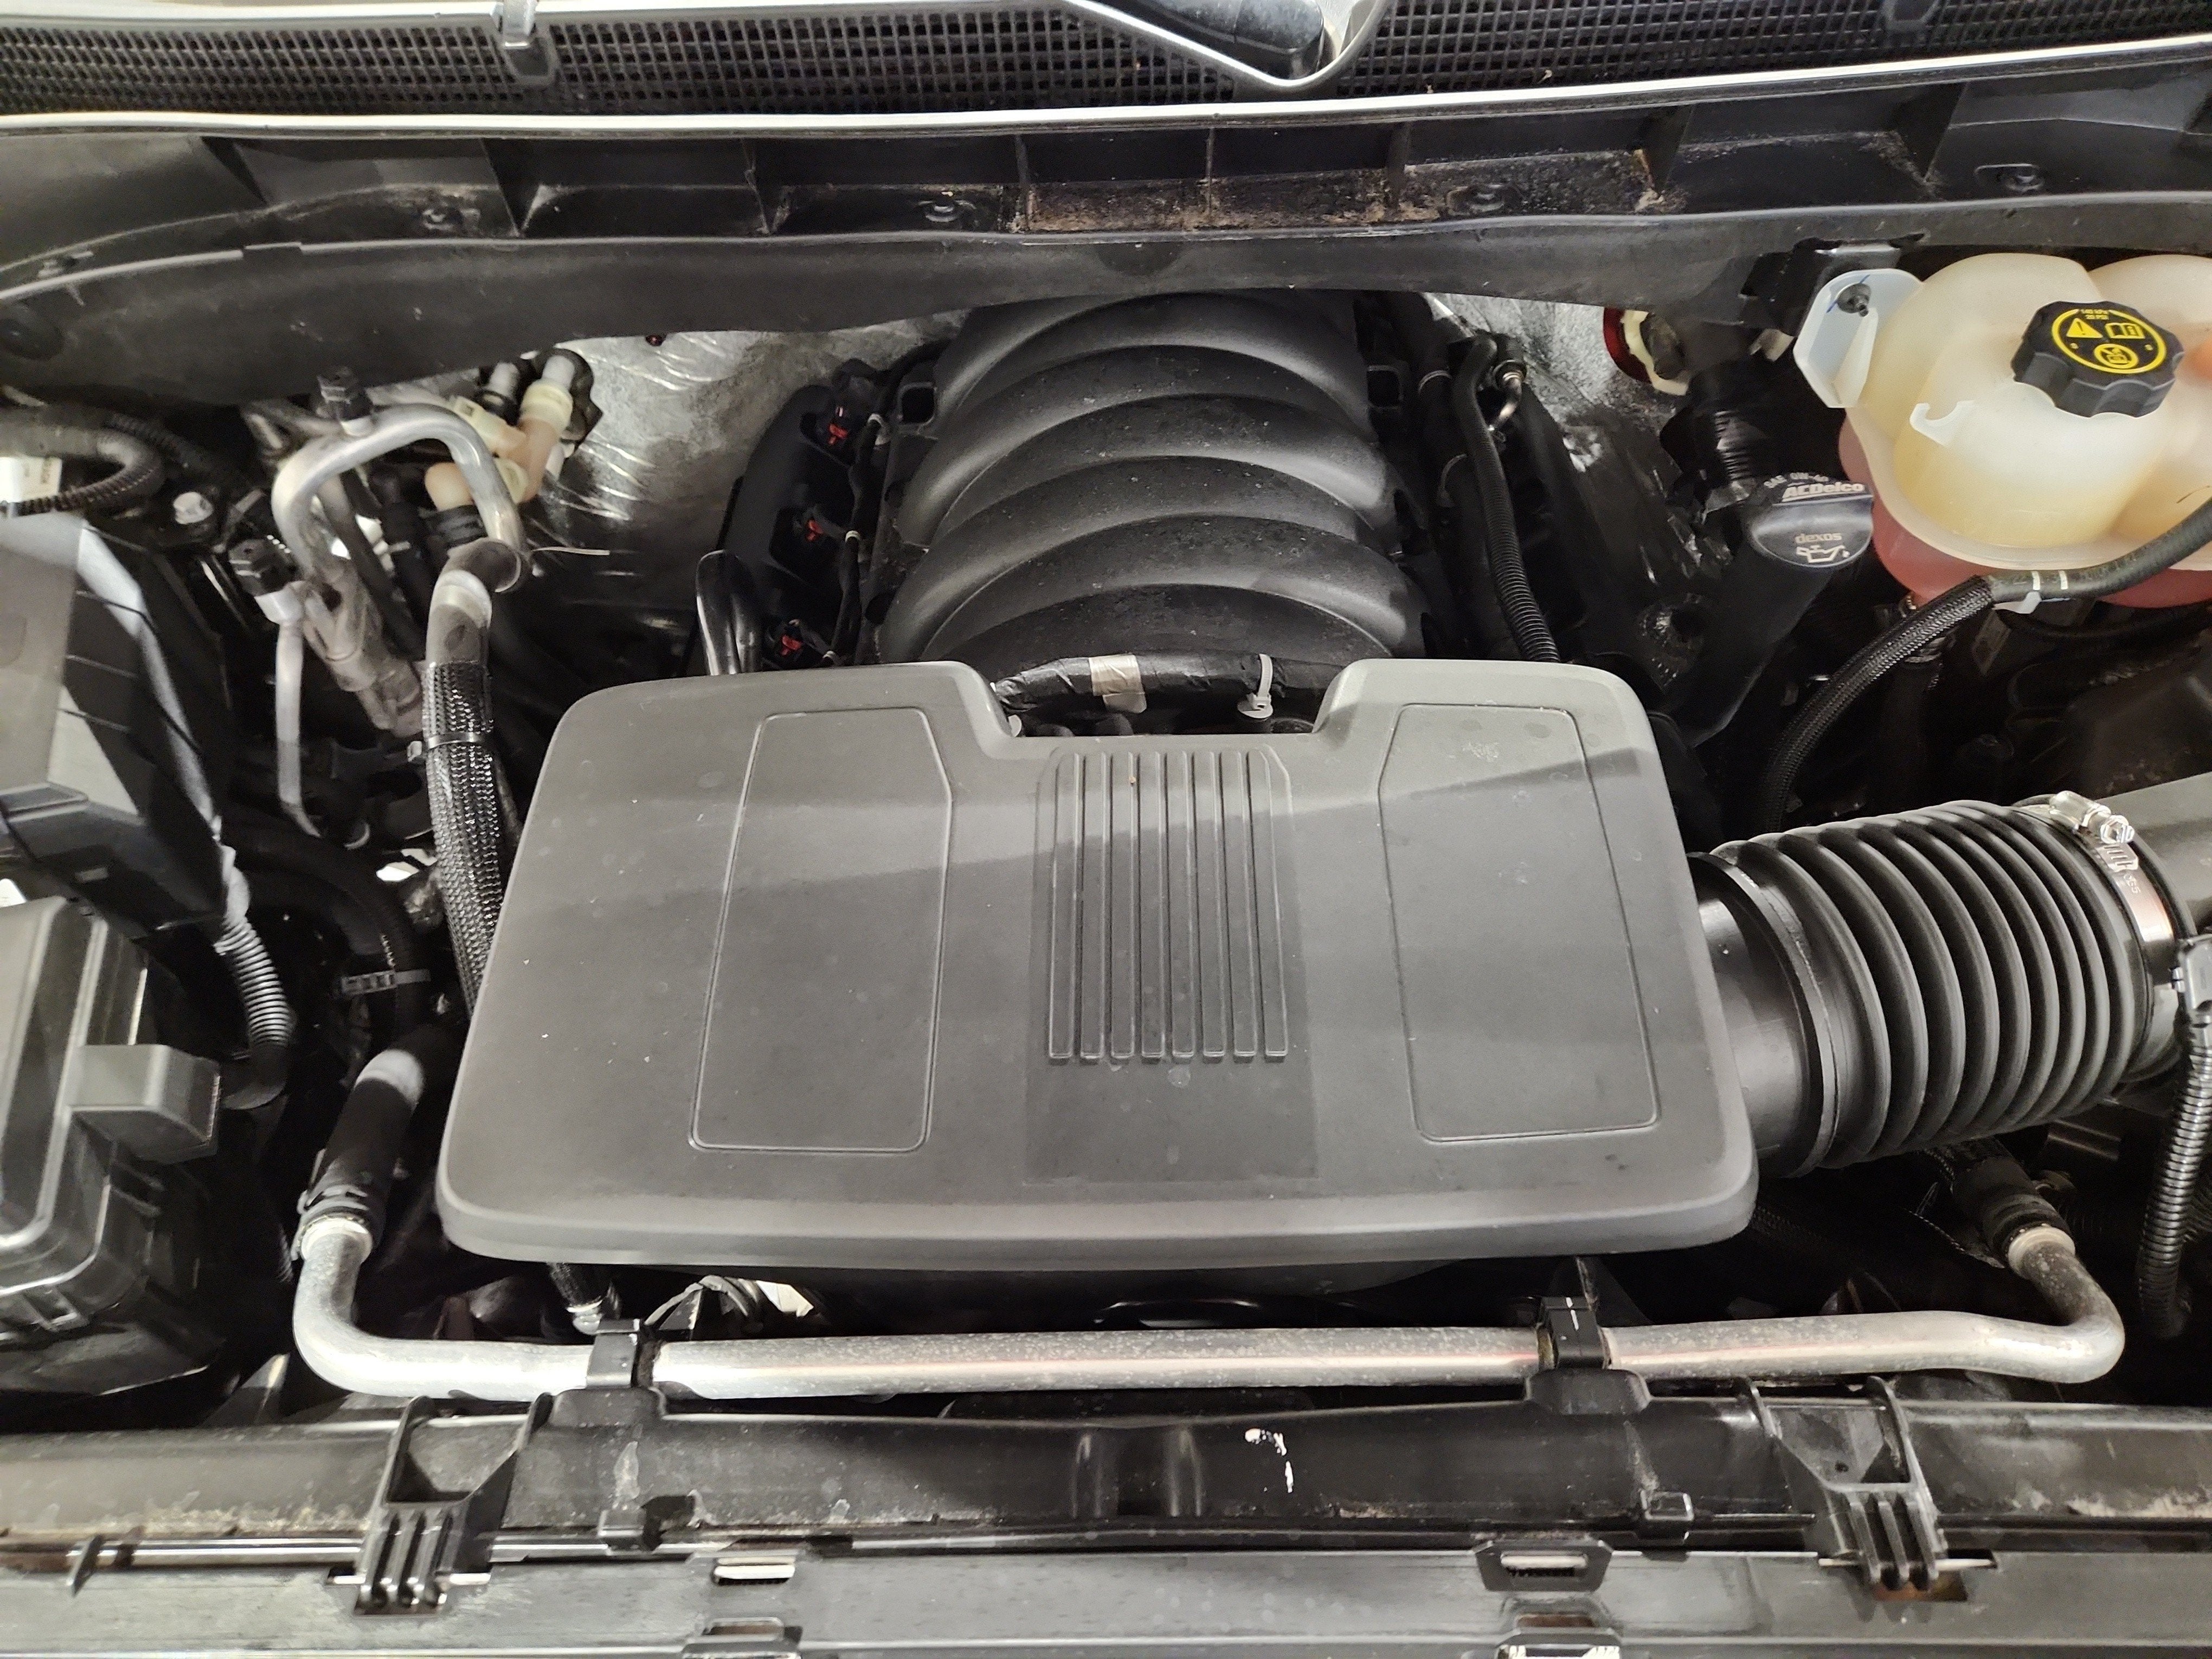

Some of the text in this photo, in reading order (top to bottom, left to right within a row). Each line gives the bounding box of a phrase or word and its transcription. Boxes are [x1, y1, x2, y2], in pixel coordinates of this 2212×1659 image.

[1763, 475, 1787, 488] SAE
[1782, 481, 1865, 499] ACDelco
[1795, 532, 1842, 544] dexos
